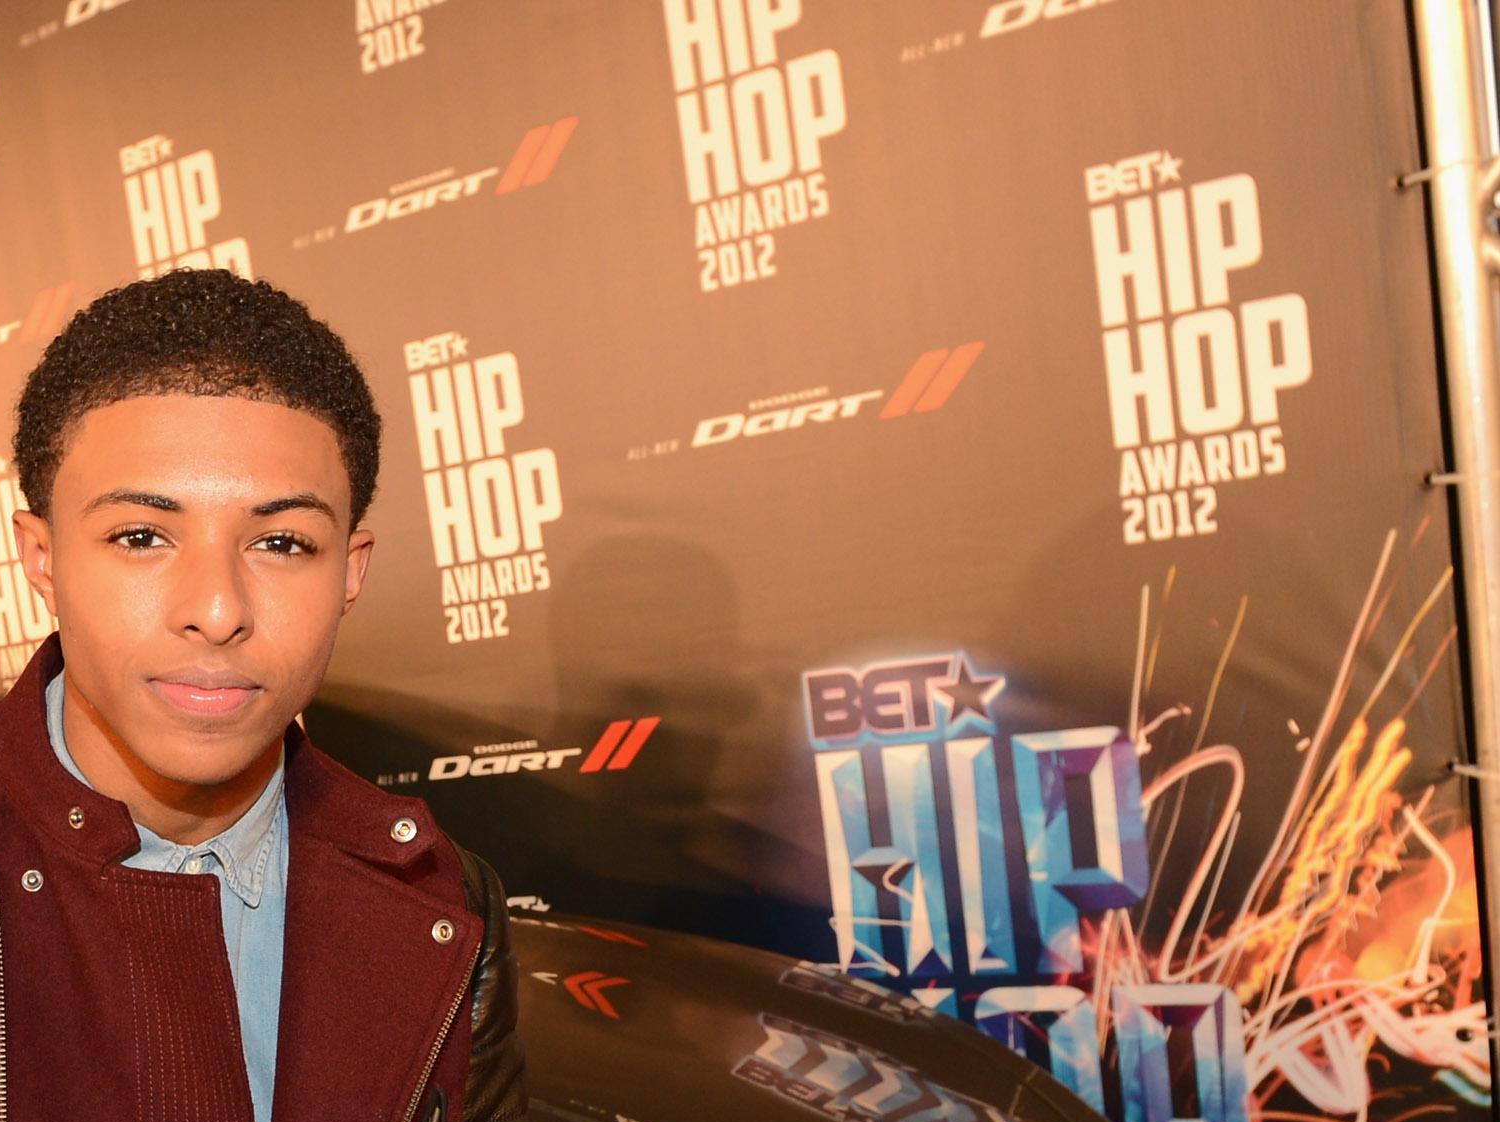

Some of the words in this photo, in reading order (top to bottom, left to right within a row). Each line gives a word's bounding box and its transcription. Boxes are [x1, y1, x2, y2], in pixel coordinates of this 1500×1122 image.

[358, 14, 425, 75] 2012
[662, 0, 802, 93] HIP
[119, 134, 163, 175] BET
[675, 48, 847, 204] HOP
[123, 148, 221, 268] HIP
[695, 171, 830, 249] AWARDS
[1084, 150, 1162, 203] BET
[698, 232, 777, 293] 2012
[1090, 172, 1263, 330] HIP
[403, 331, 455, 372] BET
[1102, 292, 1314, 450] HOP
[408, 351, 524, 472] HIP
[1118, 425, 1288, 498] AWARDS
[423, 447, 563, 568] HOP
[1121, 486, 1219, 546] 2012
[441, 551, 551, 607] AWARDS
[444, 599, 509, 645] 2012
[803, 654, 955, 746] BET
[473, 739, 538, 755] DODGE
[815, 726, 1148, 975] HIP
